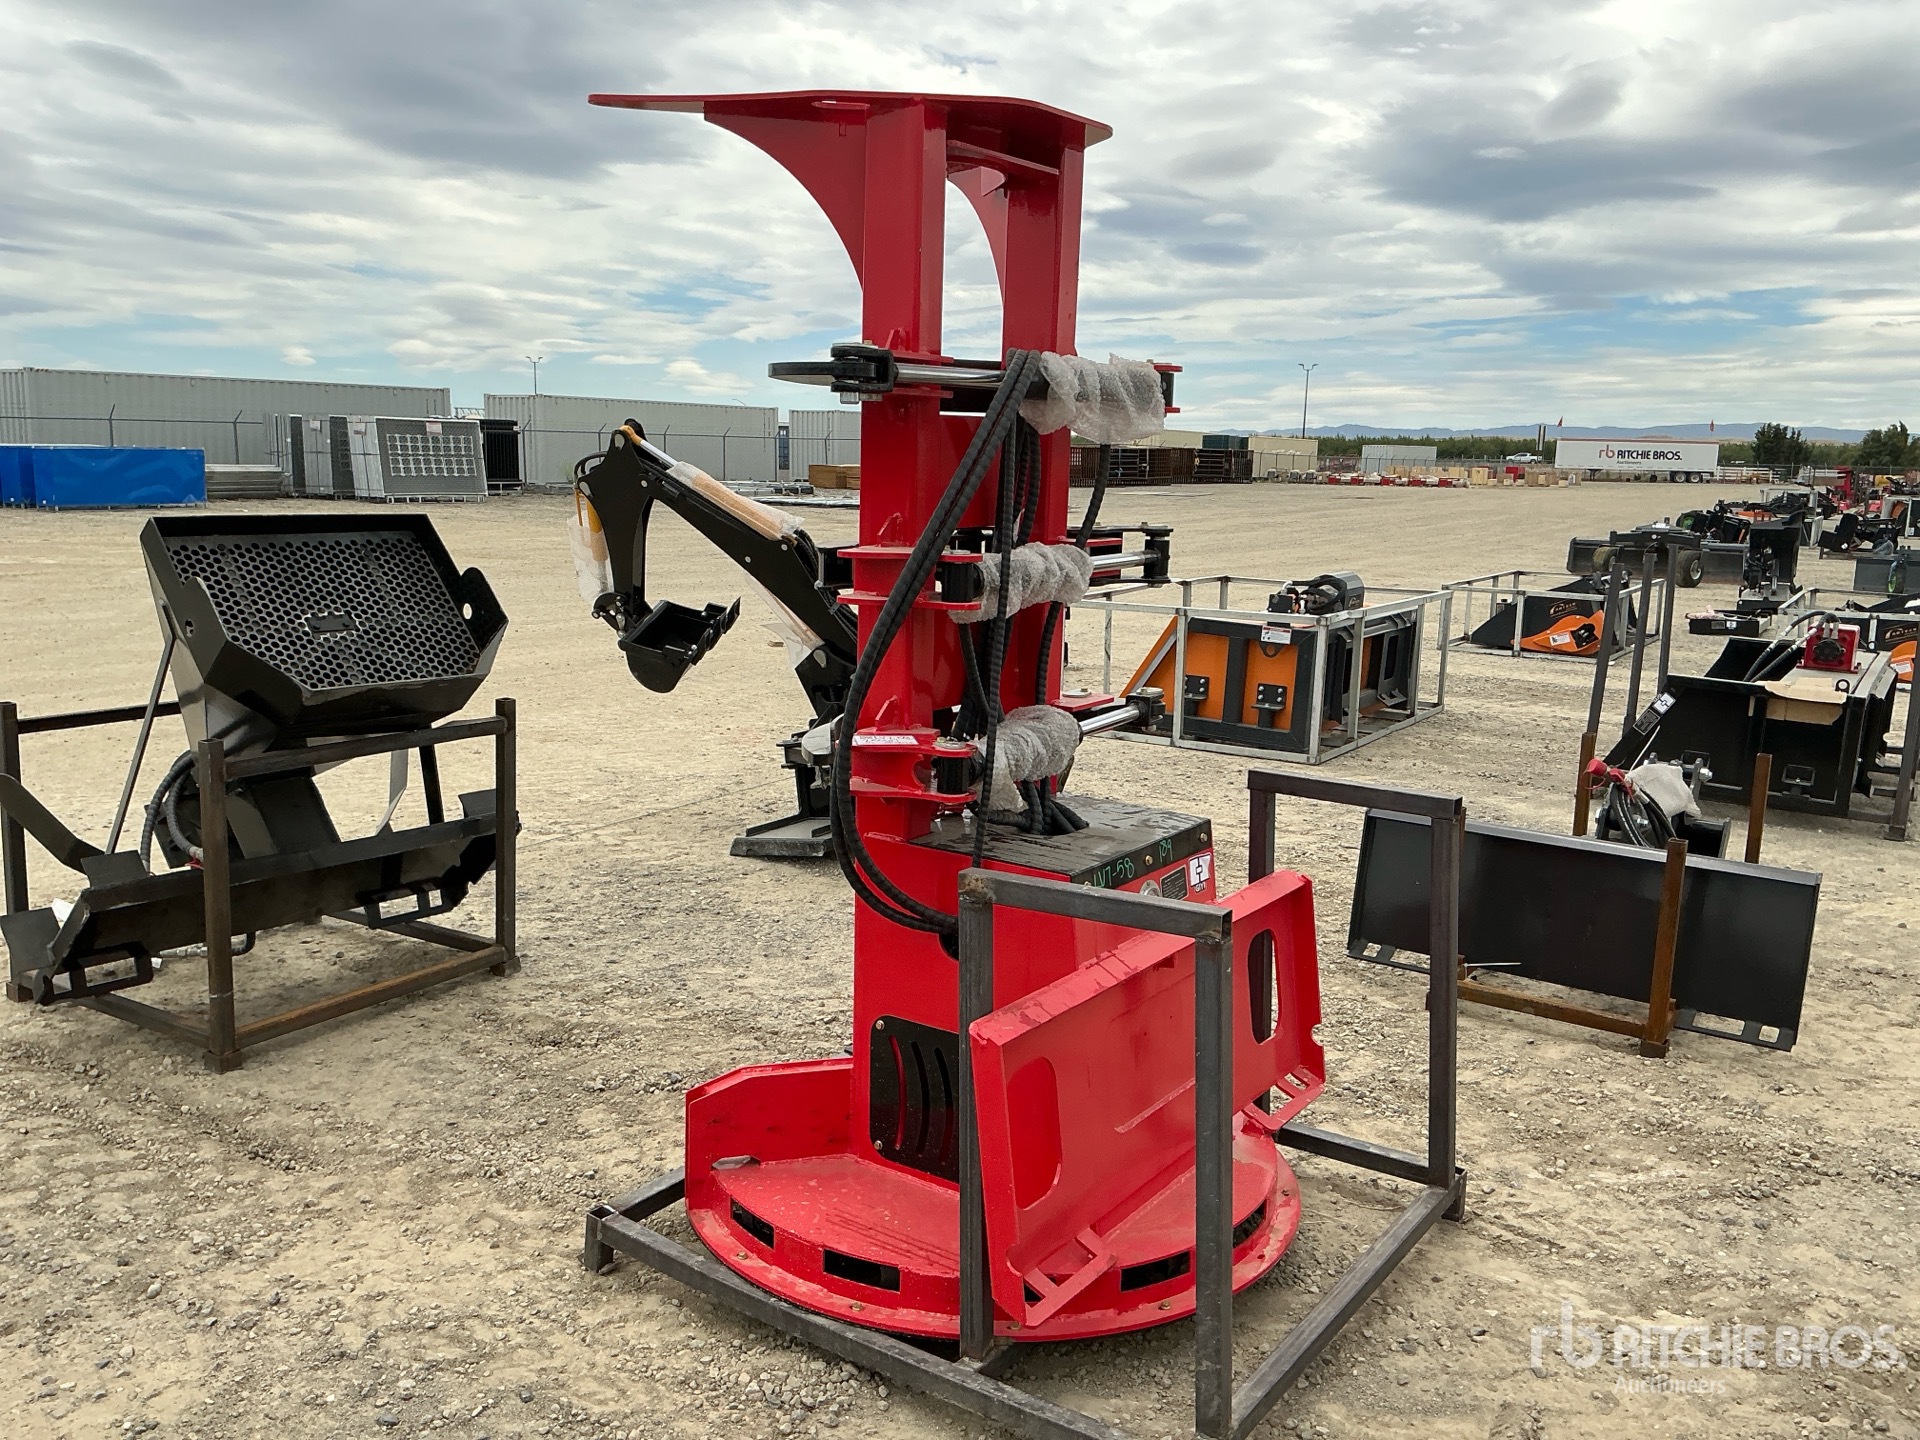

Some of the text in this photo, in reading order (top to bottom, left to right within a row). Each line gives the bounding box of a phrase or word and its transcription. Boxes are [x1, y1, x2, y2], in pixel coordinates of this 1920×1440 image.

[1617, 449, 1651, 460] RITCHIE
[1653, 450, 1683, 461] BROS.
[1158, 839, 1173, 863] 189
